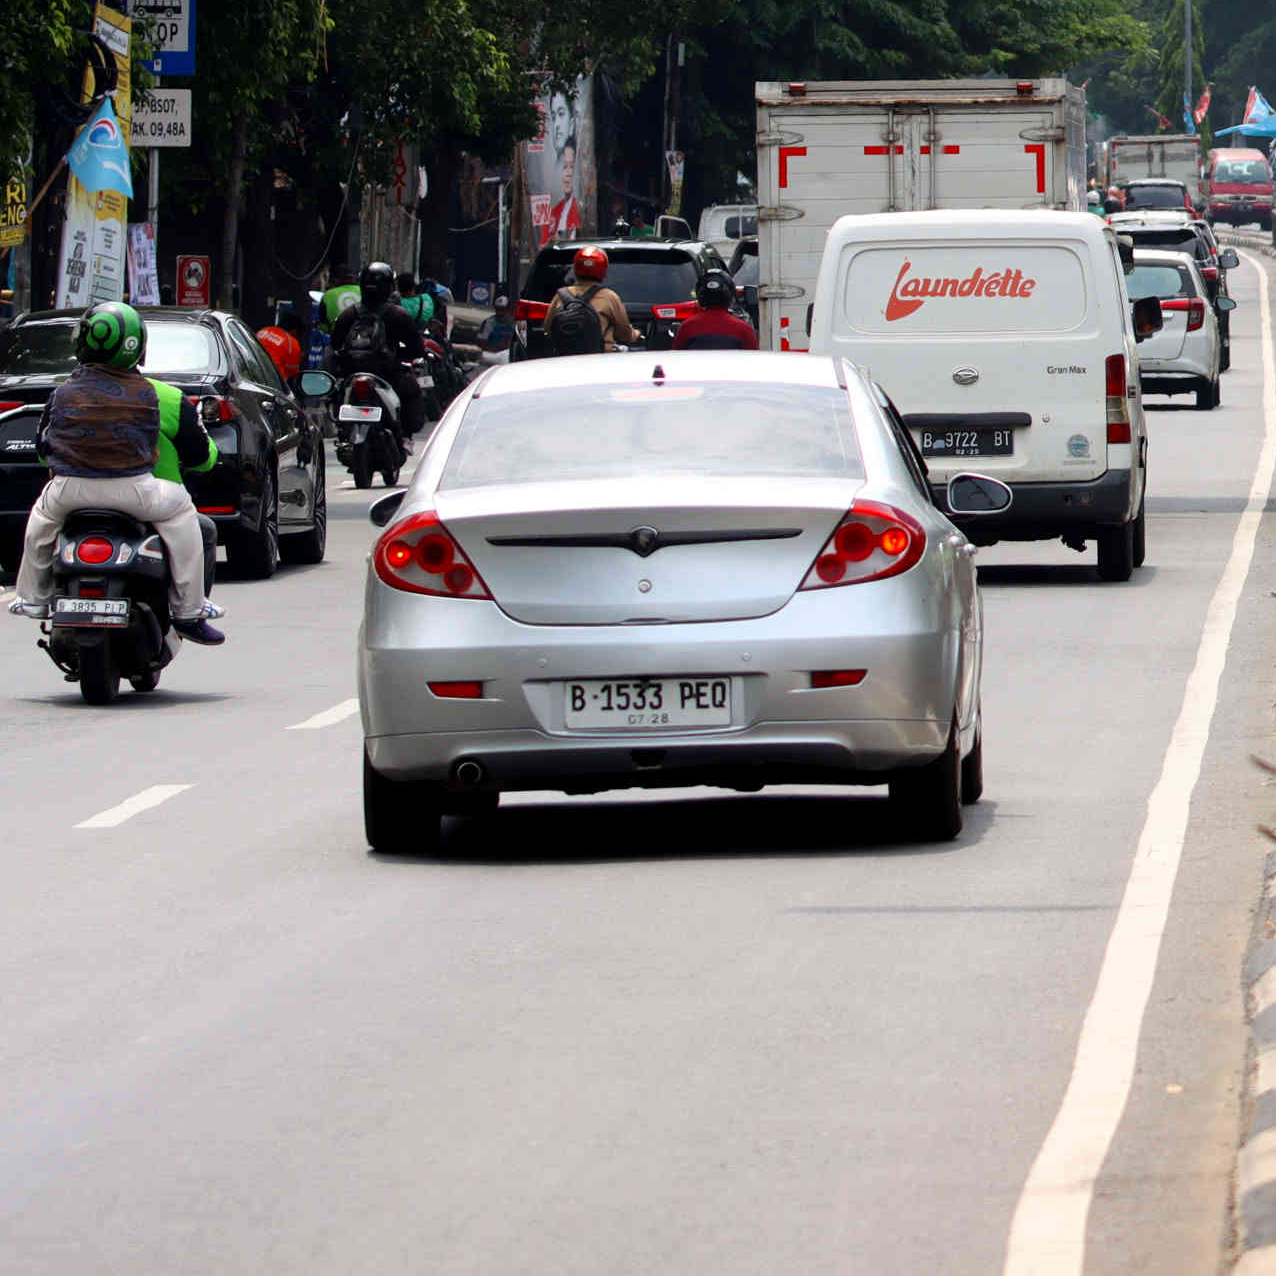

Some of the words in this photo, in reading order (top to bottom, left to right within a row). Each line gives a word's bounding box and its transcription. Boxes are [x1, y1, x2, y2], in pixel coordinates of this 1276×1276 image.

[1069, 365, 1087, 374] Max
[923, 432, 933, 448] B
[945, 432, 978, 447] 9722
[571, 684, 586, 712] B
[601, 682, 663, 710] 1533
[679, 681, 726, 709] PEQ
